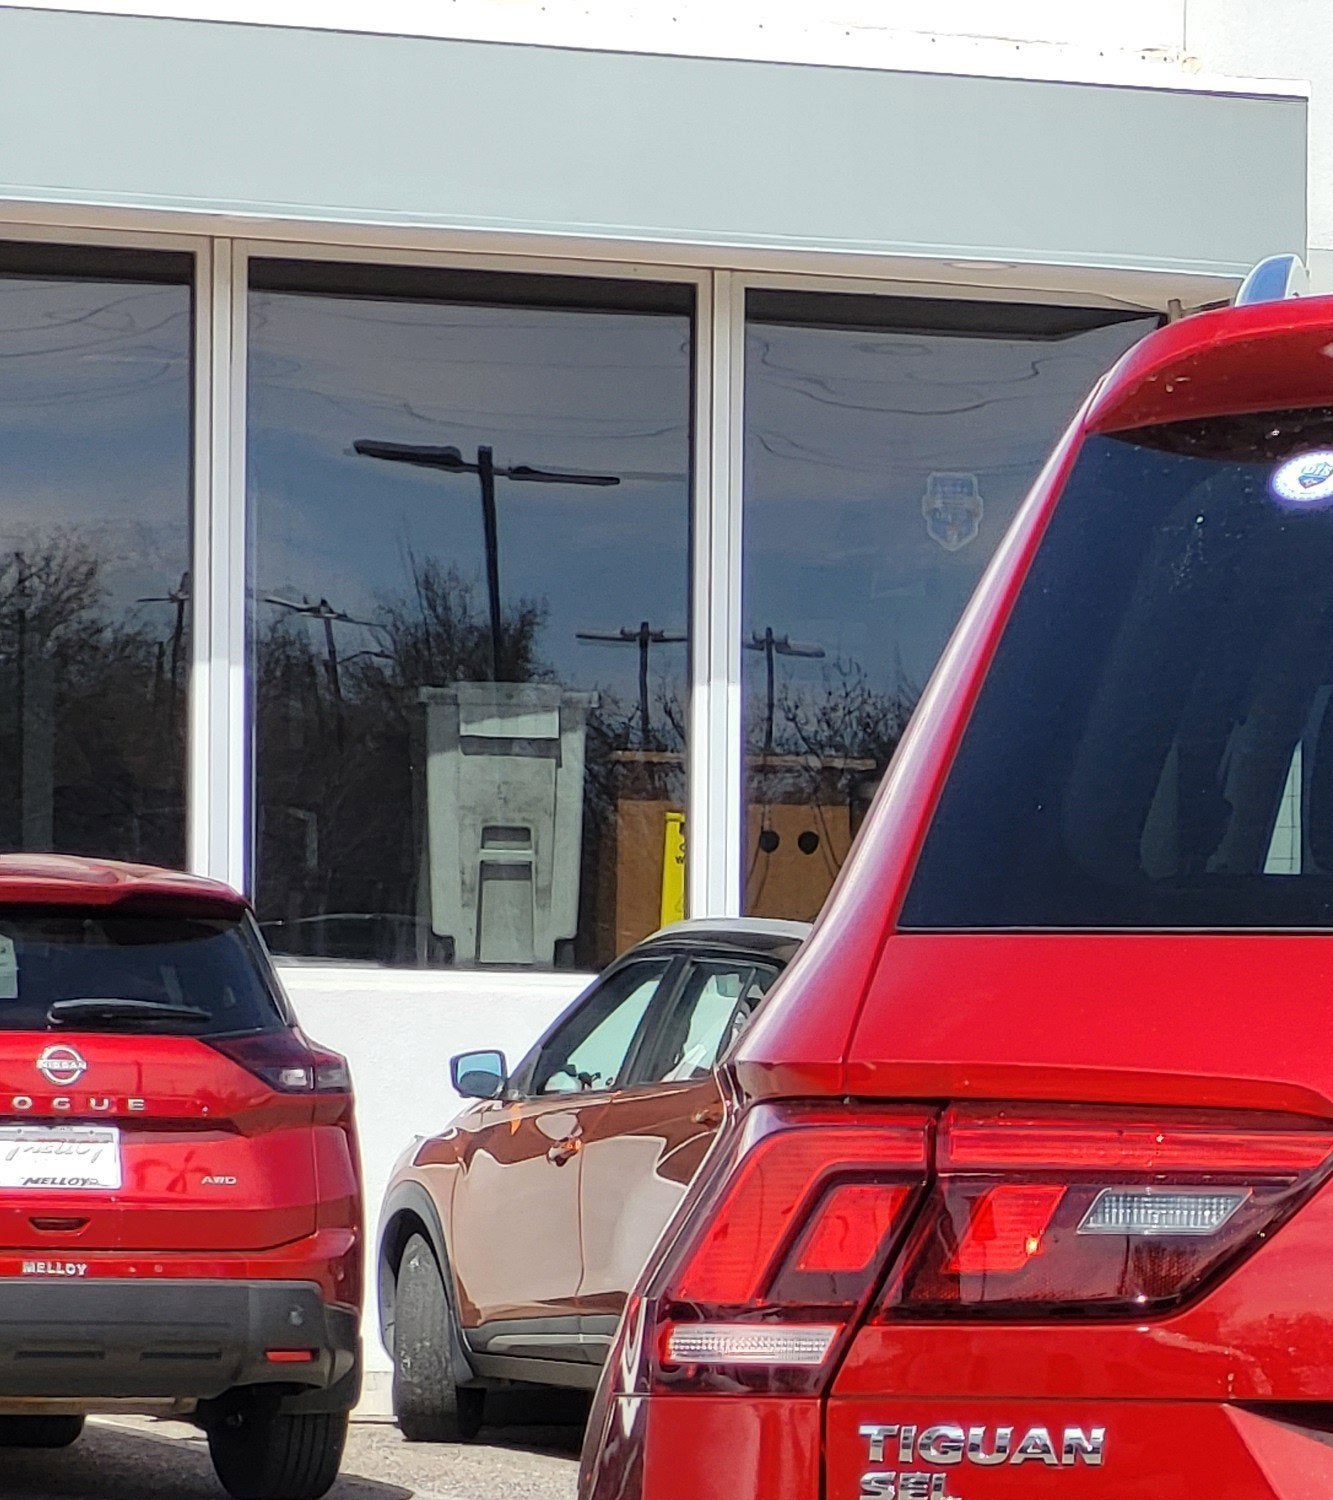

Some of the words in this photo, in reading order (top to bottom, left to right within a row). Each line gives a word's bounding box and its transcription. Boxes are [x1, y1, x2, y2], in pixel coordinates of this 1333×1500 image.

[22, 1177, 90, 1187] MELLOY
[201, 1175, 237, 1185] AWD
[22, 1261, 88, 1276] MELLOY
[858, 1425, 1105, 1466] TIGUAN
